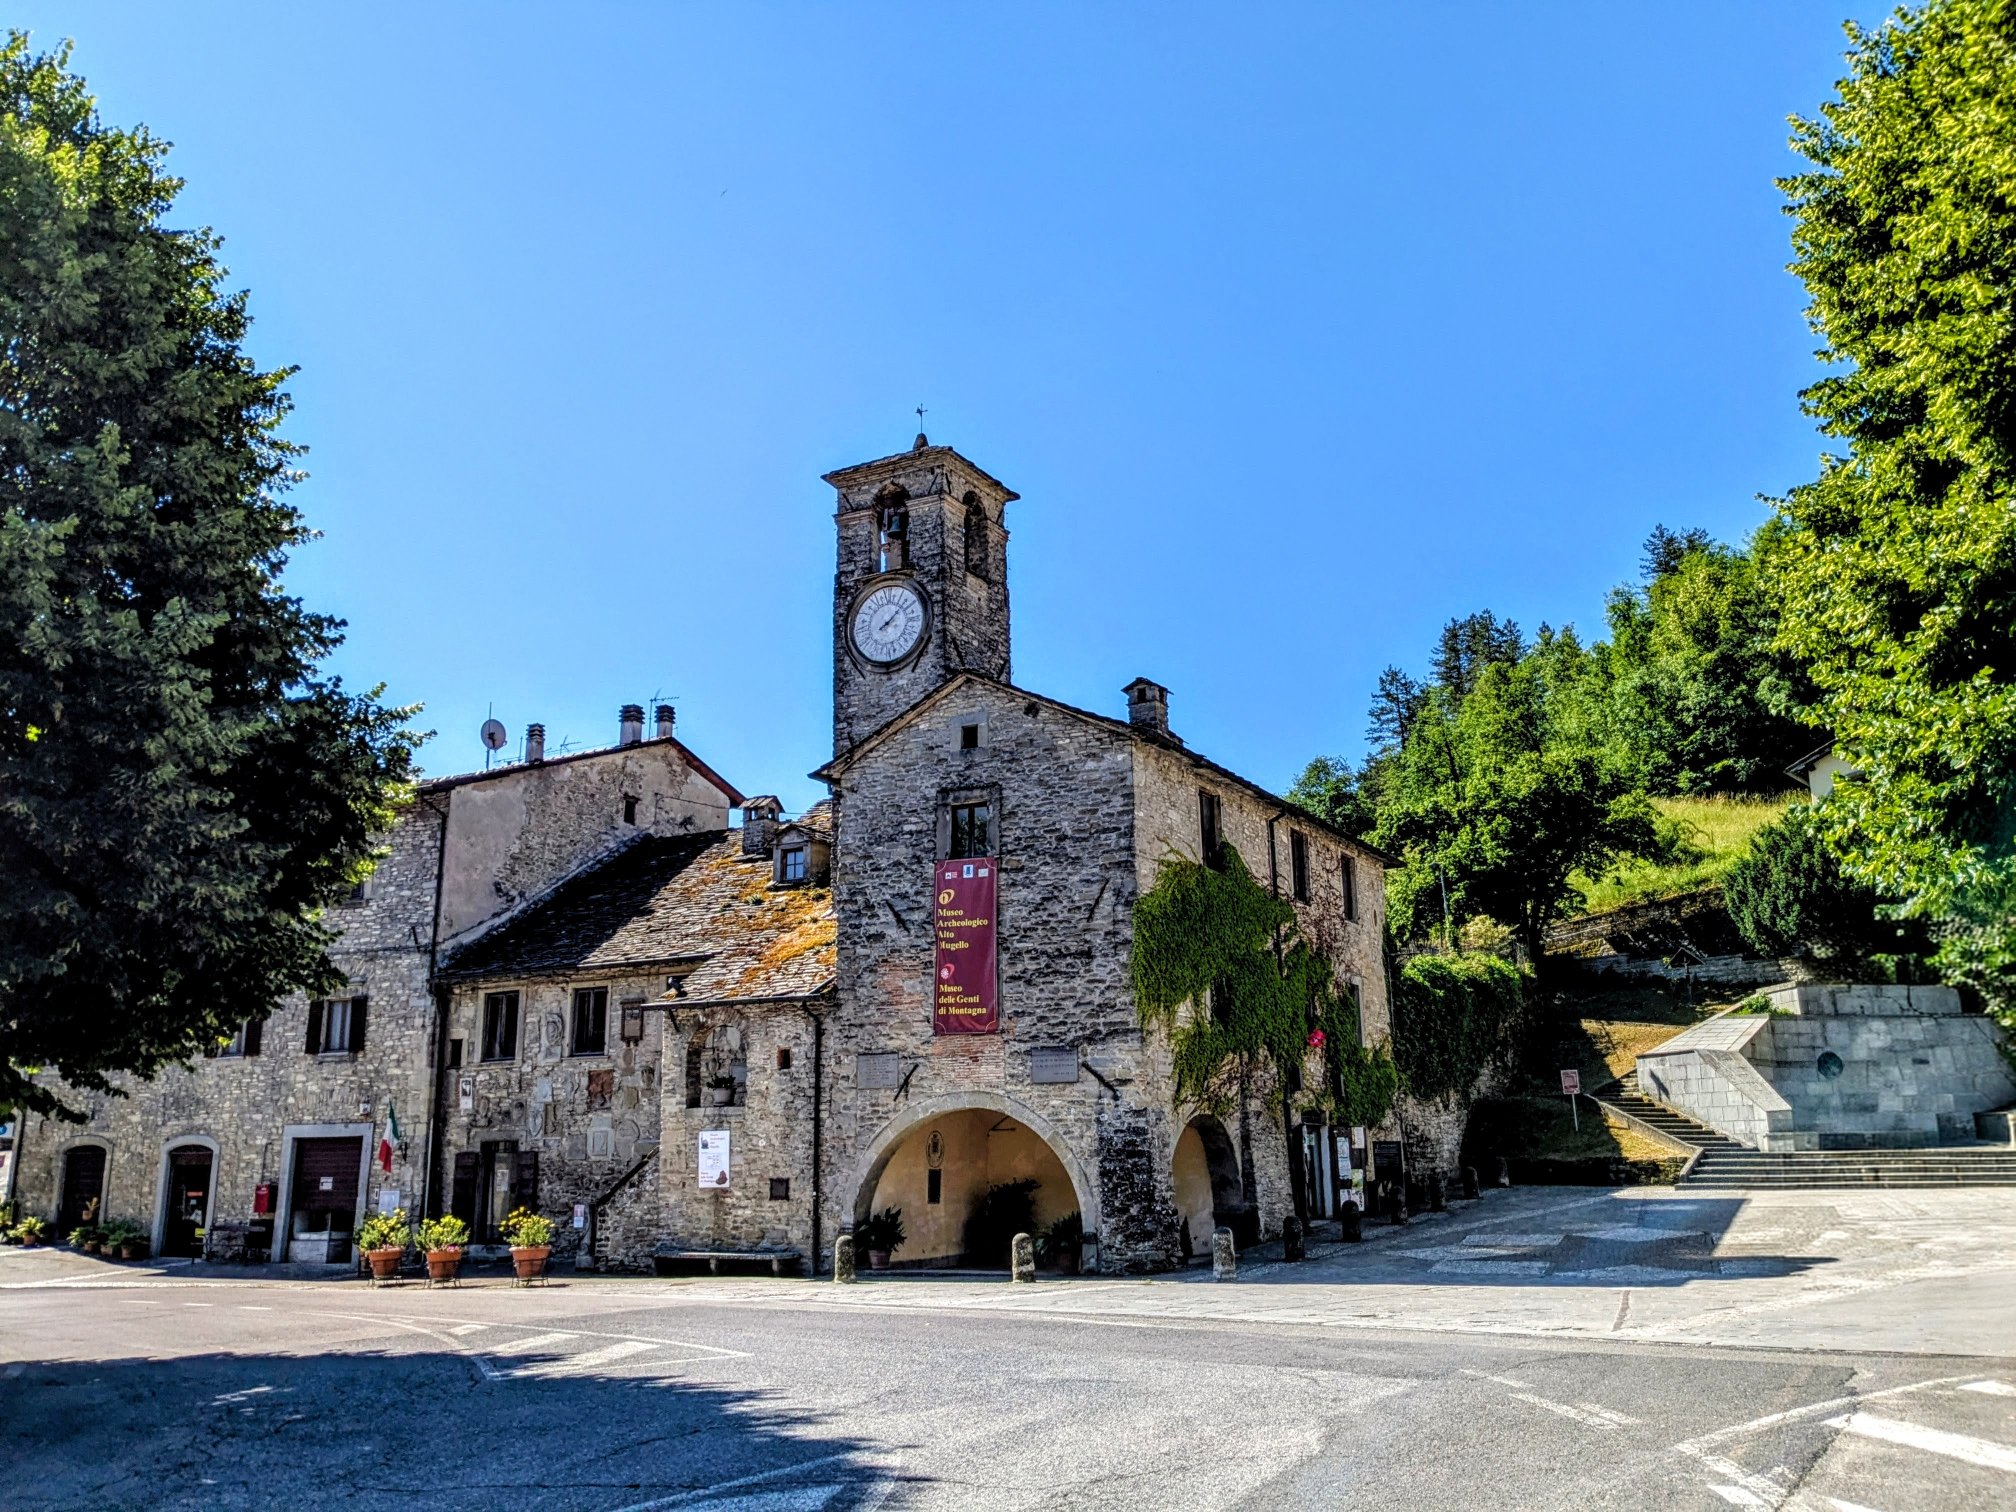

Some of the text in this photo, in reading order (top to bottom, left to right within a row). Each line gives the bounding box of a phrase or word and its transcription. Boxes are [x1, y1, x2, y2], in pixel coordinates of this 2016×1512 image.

[937, 918, 988, 928] Archeologico
[938, 930, 955, 938] Alto
[939, 984, 962, 992] Museo
[938, 994, 980, 1004] delle Genti
[938, 1006, 987, 1016] di Montagna
